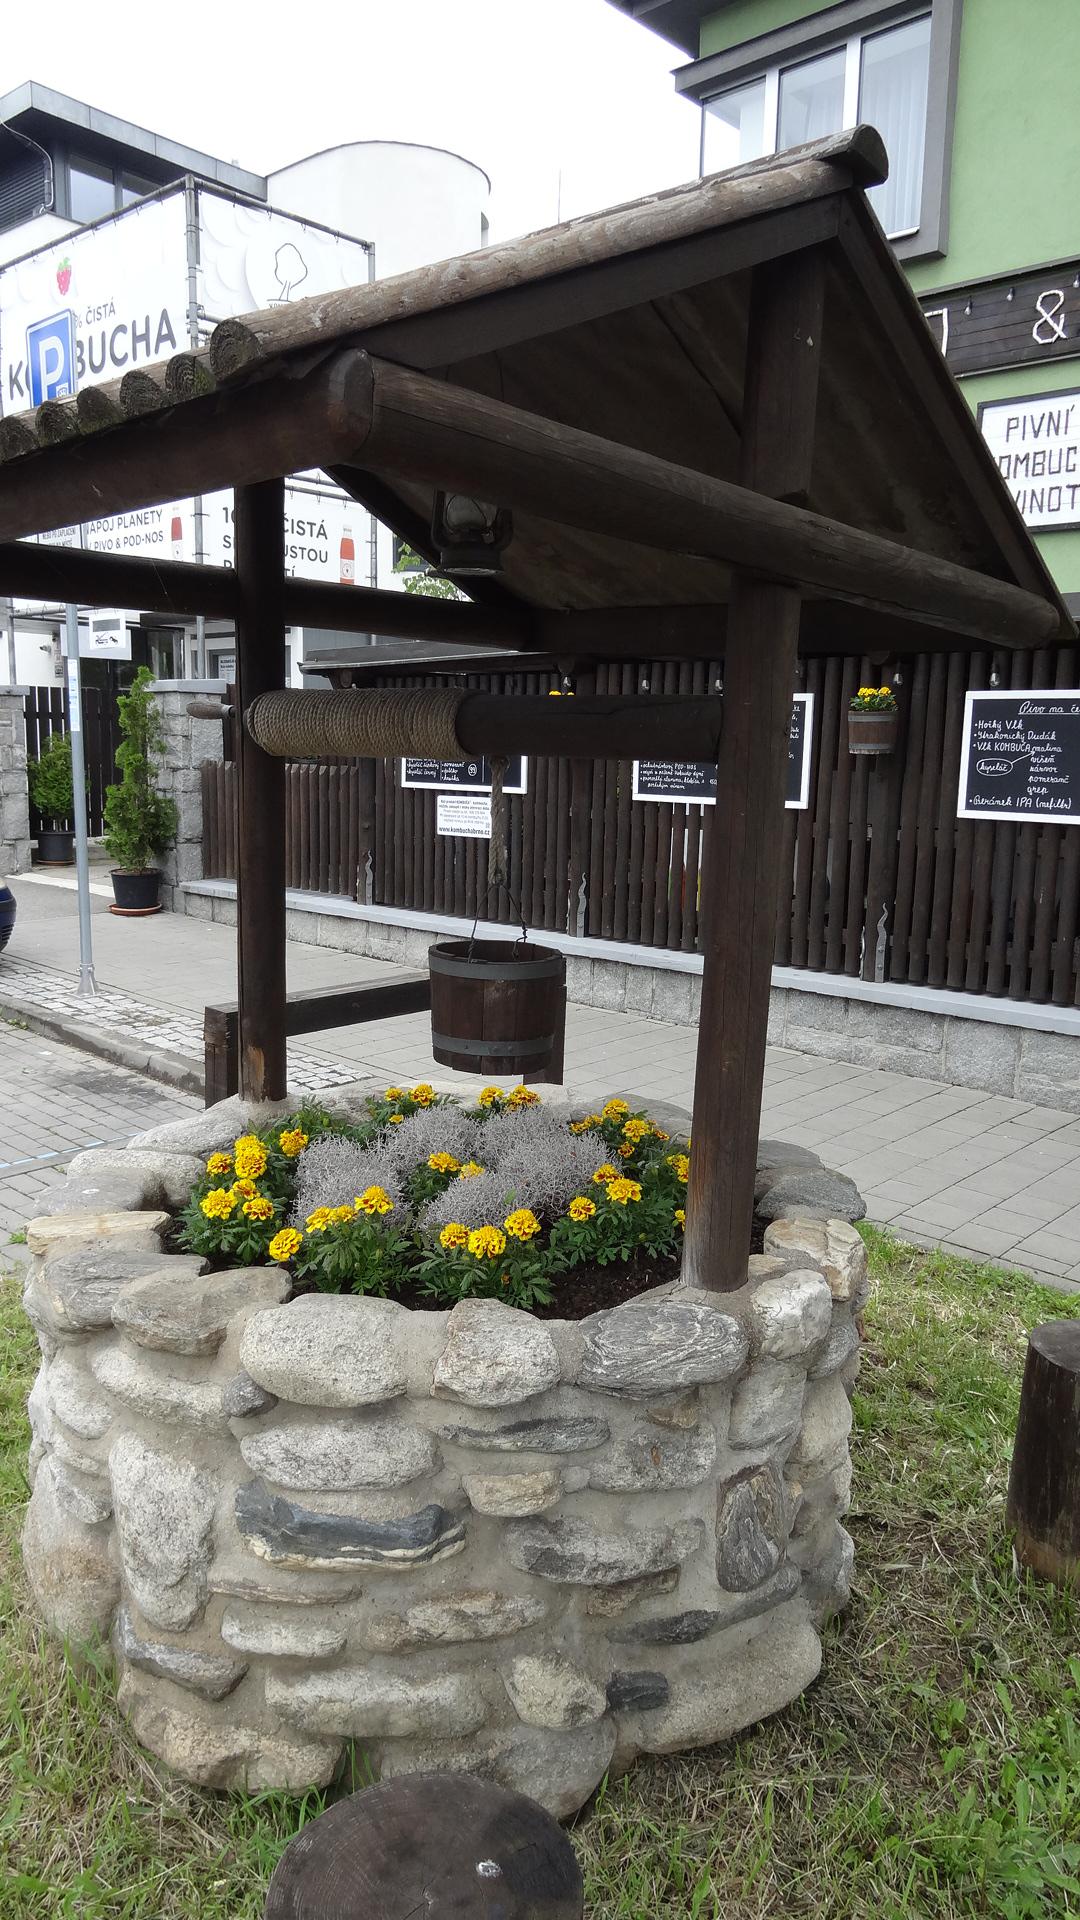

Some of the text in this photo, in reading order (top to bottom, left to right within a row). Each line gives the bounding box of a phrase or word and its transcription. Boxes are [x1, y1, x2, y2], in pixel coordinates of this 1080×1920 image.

[85, 296, 116, 325] ČISTÁ
[1032, 289, 1067, 345] &
[9, 308, 177, 401] KBUCHA
[39, 335, 65, 401] P
[1005, 404, 1075, 443] PIVNÍ
[993, 446, 1078, 480] OMBUC
[117, 509, 163, 530] PLANETY
[1019, 700, 1080, 714] Pivo na če
[978, 719, 1024, 732] Hořký Vlk
[1027, 730, 1056, 741] Dudák
[977, 741, 1062, 753] Vlk KOMBUČA malina
[1027, 775, 1070, 784] pomeranč
[1026, 786, 1049, 796] grep
[973, 794, 1012, 806] Beránek
[1016, 797, 1032, 808] IPA
